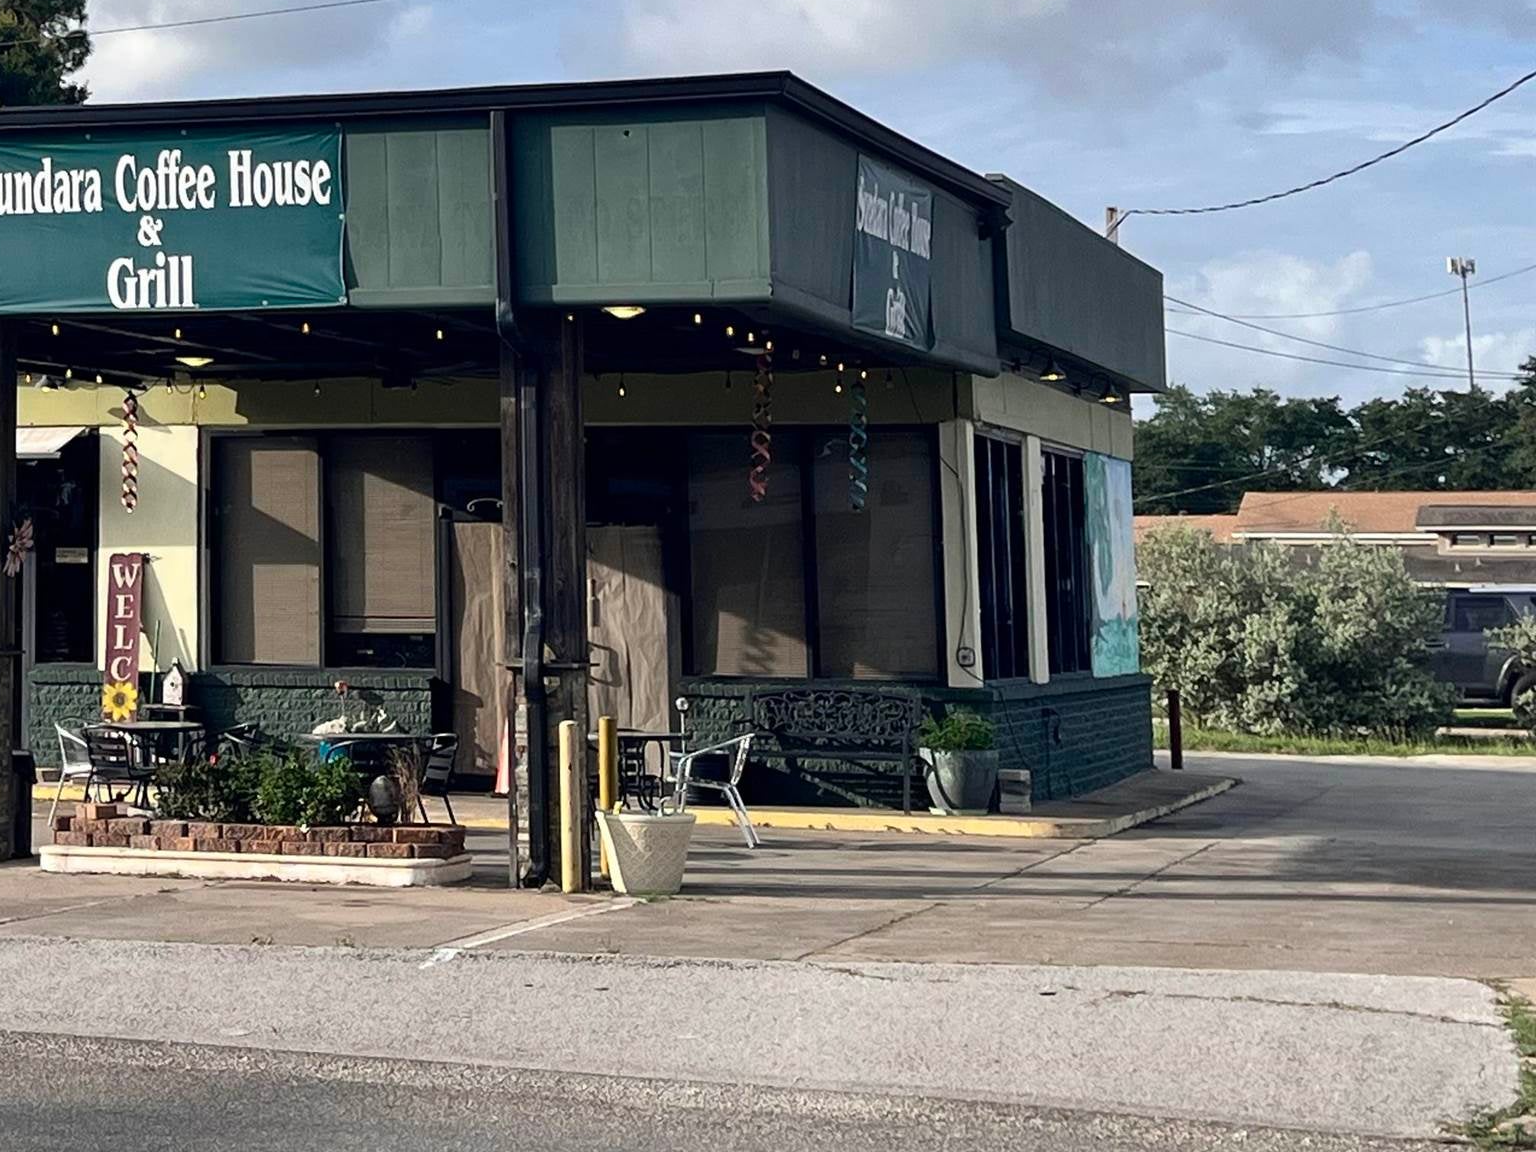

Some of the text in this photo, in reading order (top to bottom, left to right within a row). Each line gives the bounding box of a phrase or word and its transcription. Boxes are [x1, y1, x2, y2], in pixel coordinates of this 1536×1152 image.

[114, 149, 216, 212] Coffee
[227, 150, 332, 207] House
[137, 215, 164, 246] &
[107, 251, 195, 309] Grill
